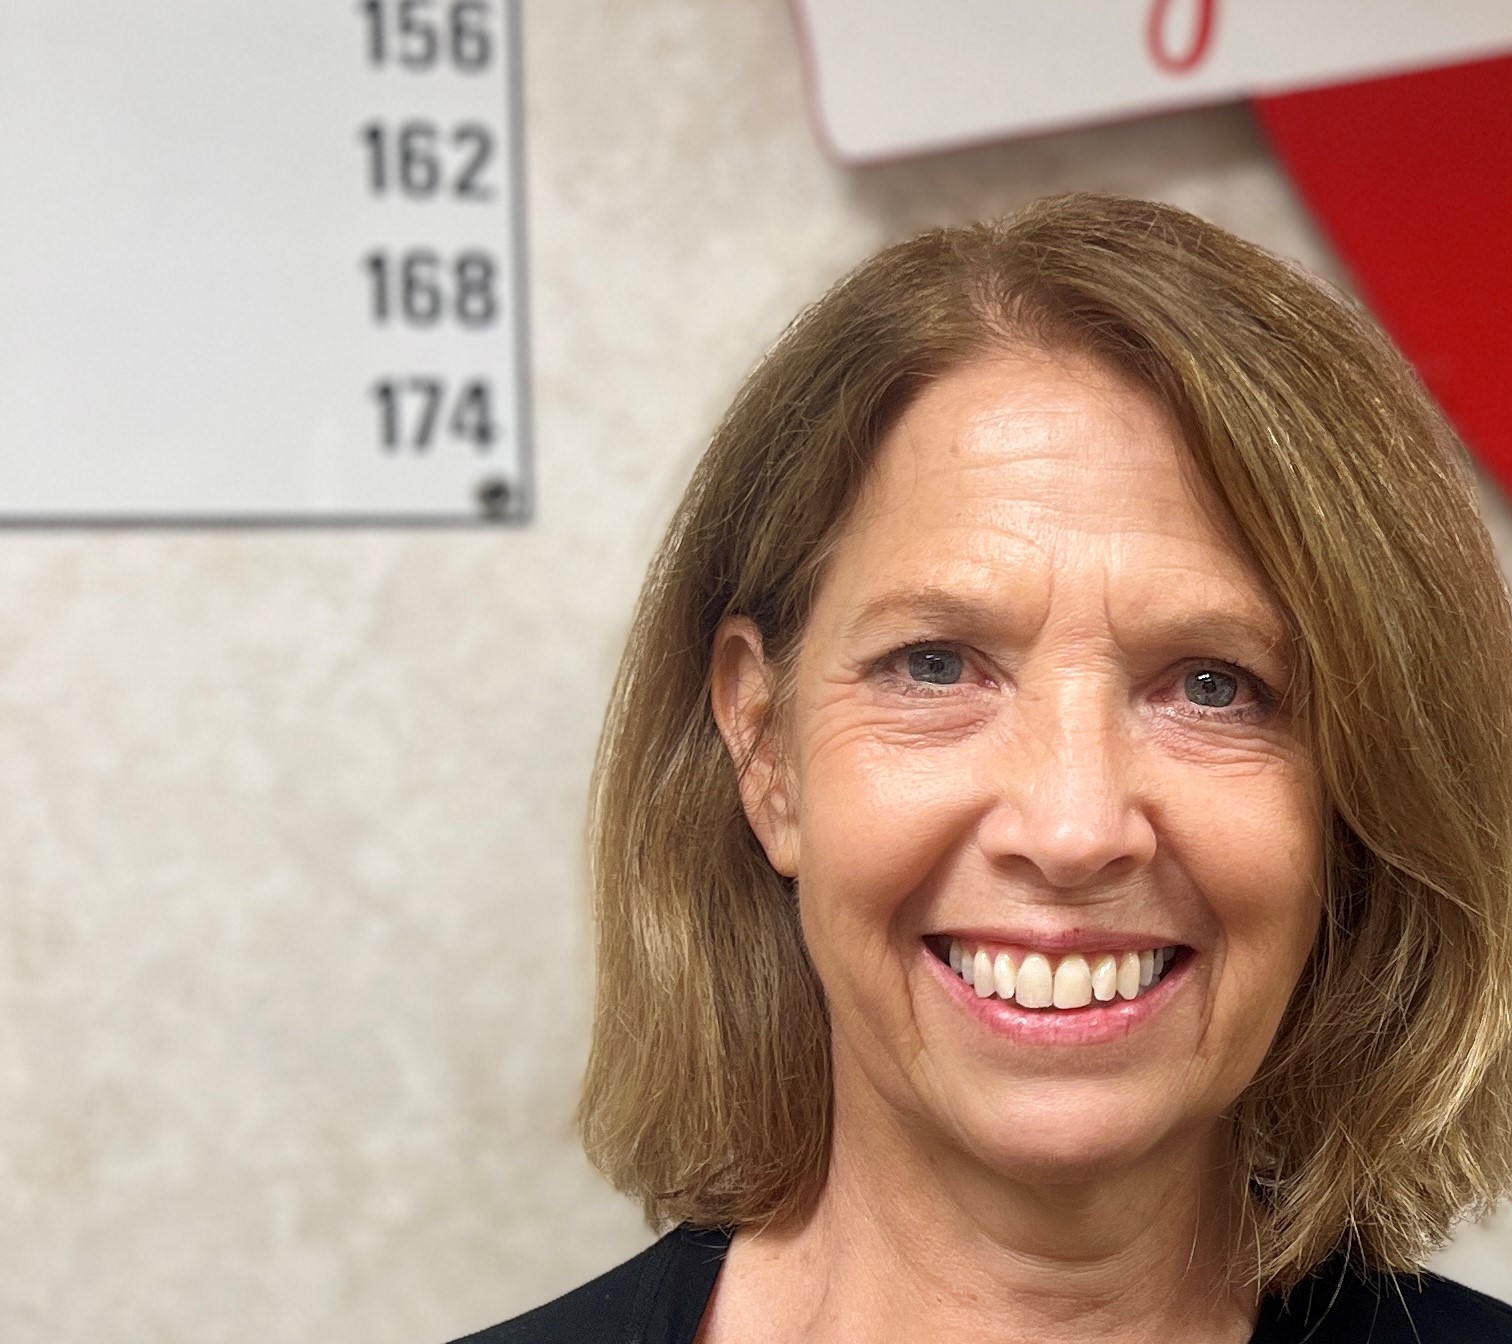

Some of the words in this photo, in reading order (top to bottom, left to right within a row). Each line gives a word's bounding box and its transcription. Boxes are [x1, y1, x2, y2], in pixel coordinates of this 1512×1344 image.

[358, 119, 497, 203] 162
[361, 247, 501, 331] 168
[370, 375, 499, 454] 174
